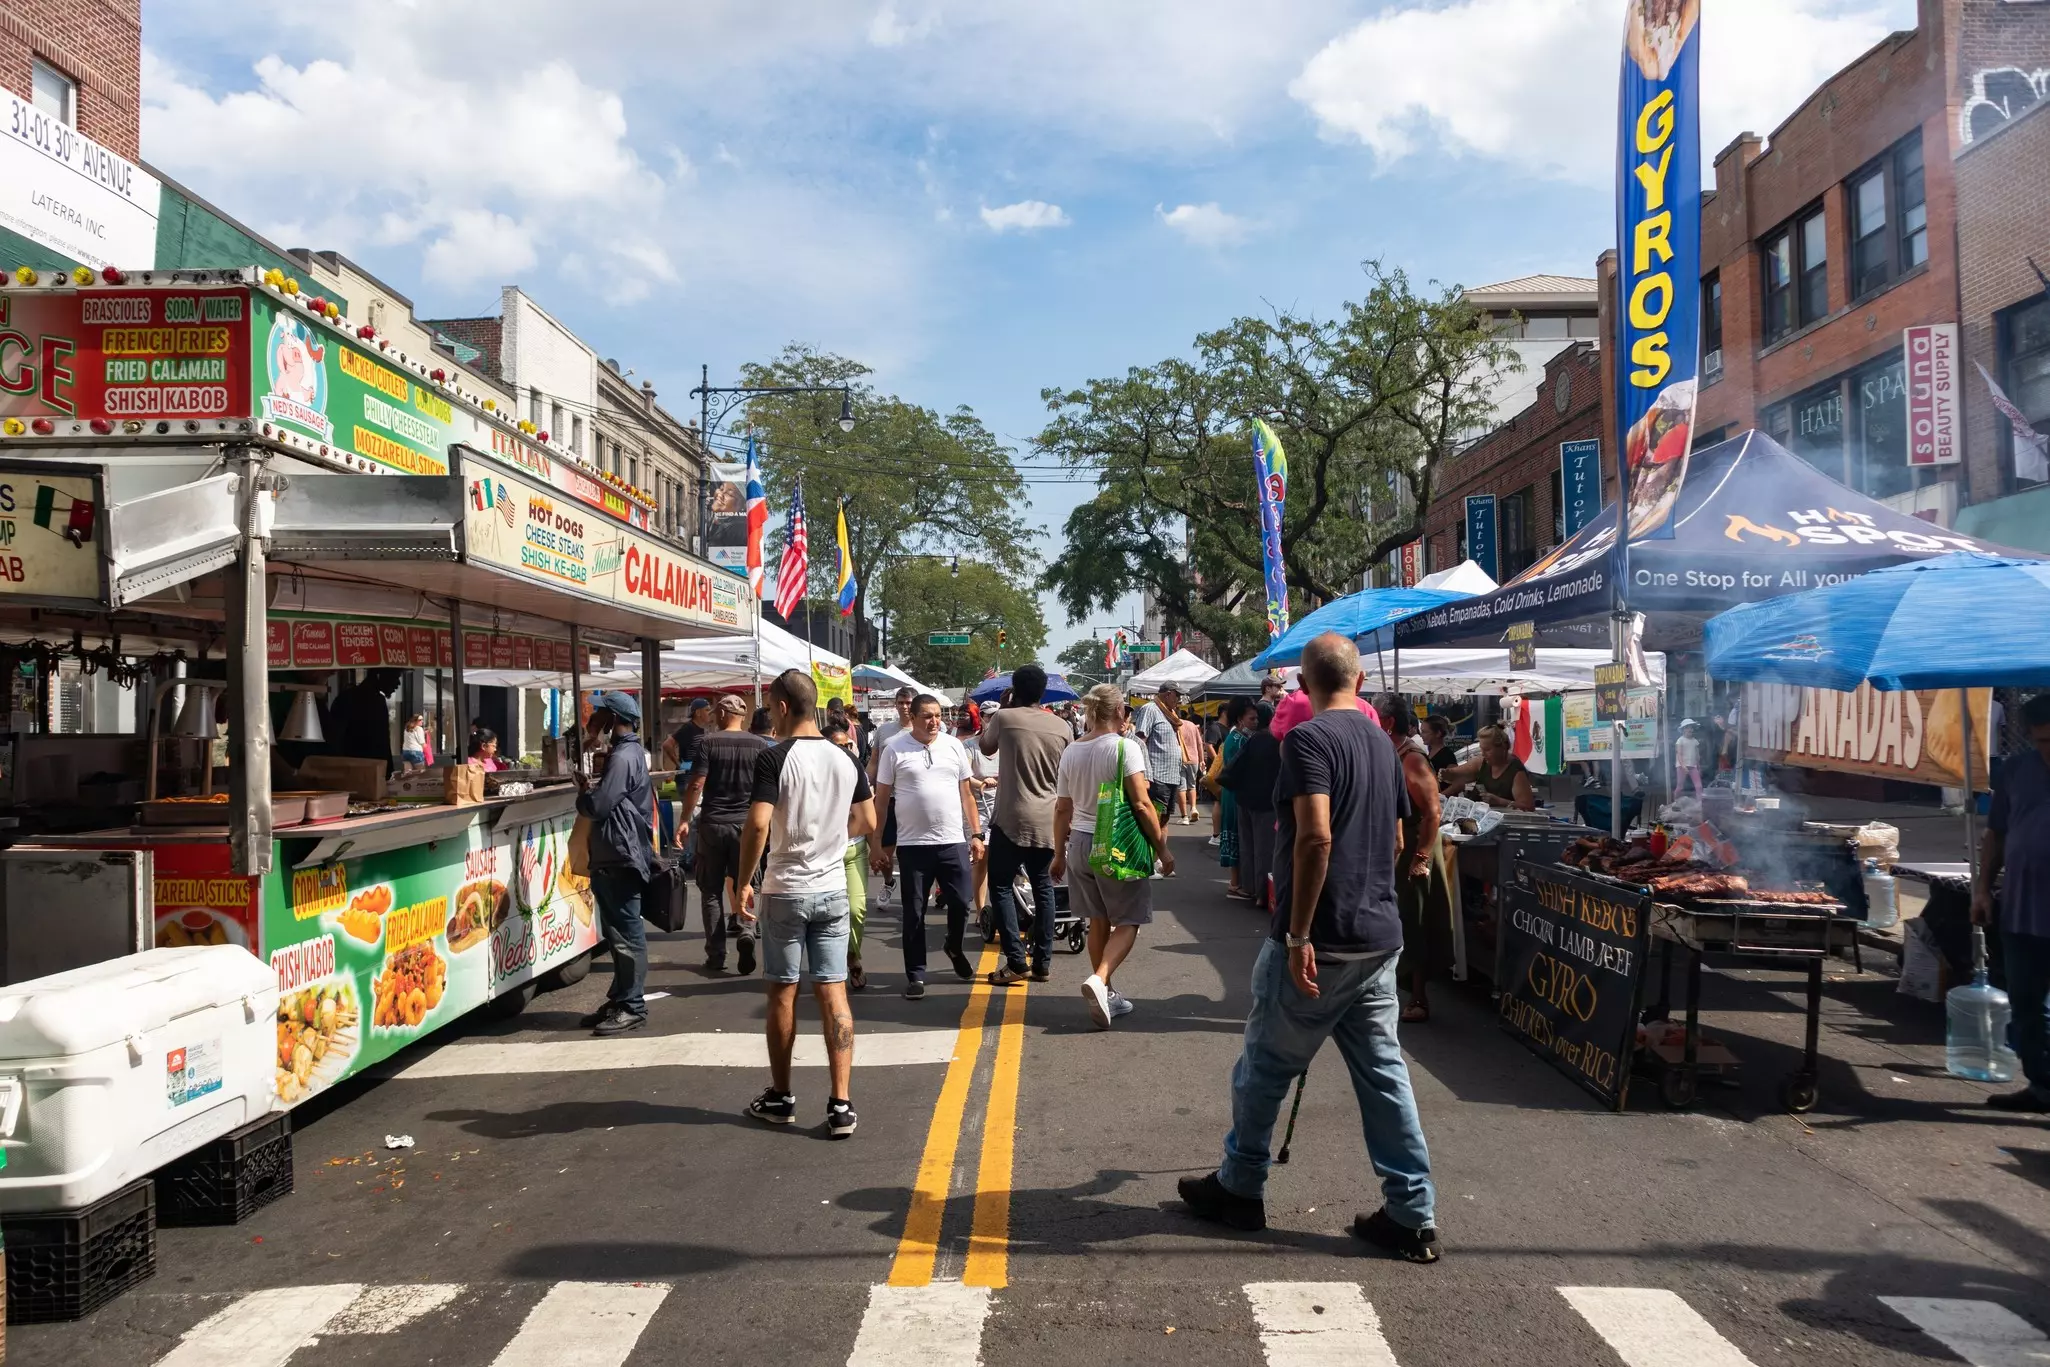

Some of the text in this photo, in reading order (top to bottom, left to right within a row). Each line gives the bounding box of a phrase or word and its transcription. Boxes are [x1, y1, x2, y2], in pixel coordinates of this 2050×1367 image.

[11, 99, 51, 152] 31-01
[82, 141, 132, 197] AVENUE
[31, 189, 107, 240] LATERRA INC.
[1628, 88, 1676, 389] GYROS
[84, 300, 150, 321] BRASCIOLES
[105, 329, 228, 351] FRENCH FRIES
[106, 359, 225, 381] FRIED CALAMARI
[340, 347, 408, 402] CHICKEN CUTLETS
[107, 389, 226, 412] SHISH KABOB
[1800, 371, 1908, 436] HAIR SPA
[1912, 336, 1933, 455] soluna
[1935, 332, 1953, 458] BEAUTY SUPPLY
[272, 399, 325, 430] NED'S SAUSAGE
[365, 396, 439, 449] PHILLY CHEESESTEAK
[354, 428, 446, 475] MOZZARELLA STICKS
[491, 429, 551, 481] ITALIAN
[528, 502, 584, 539] HOT DOGS
[1796, 526, 1988, 552] SPOT
[525, 523, 585, 561] CHEESE STEAKS
[1404, 547, 1413, 572] FOR
[521, 545, 587, 582] SHISH KE-BAB
[626, 546, 712, 614] CALAMARI
[1635, 569, 1679, 587] One
[1685, 570, 1736, 591] Stop
[1742, 569, 1772, 588] for
[1780, 570, 1807, 588] All
[1450, 602, 1492, 626] Empanadas,
[1494, 593, 1515, 615] Cold
[1515, 588, 1545, 611] Drinks,
[1546, 570, 1603, 603] Lemonade
[300, 623, 327, 640] Famous
[309, 642, 331, 650] CALAMARI
[340, 625, 373, 636] CHICKEN
[341, 637, 374, 647] TENDERS
[384, 628, 404, 643] CORN
[386, 648, 406, 664] DOGS
[1747, 679, 1923, 770] EMPANADAS
[465, 846, 498, 881] SAUSAGE
[208, 881, 250, 903] STICKS
[293, 871, 320, 915] CORN
[386, 898, 447, 952] FRIED CALAMARI
[491, 903, 574, 975] Ned's Food
[303, 937, 334, 984] KABOB
[1559, 926, 1595, 963] LAMB
[1528, 951, 1597, 1022] GYRO
[1500, 992, 1617, 1091] CHICKEN over RICE
